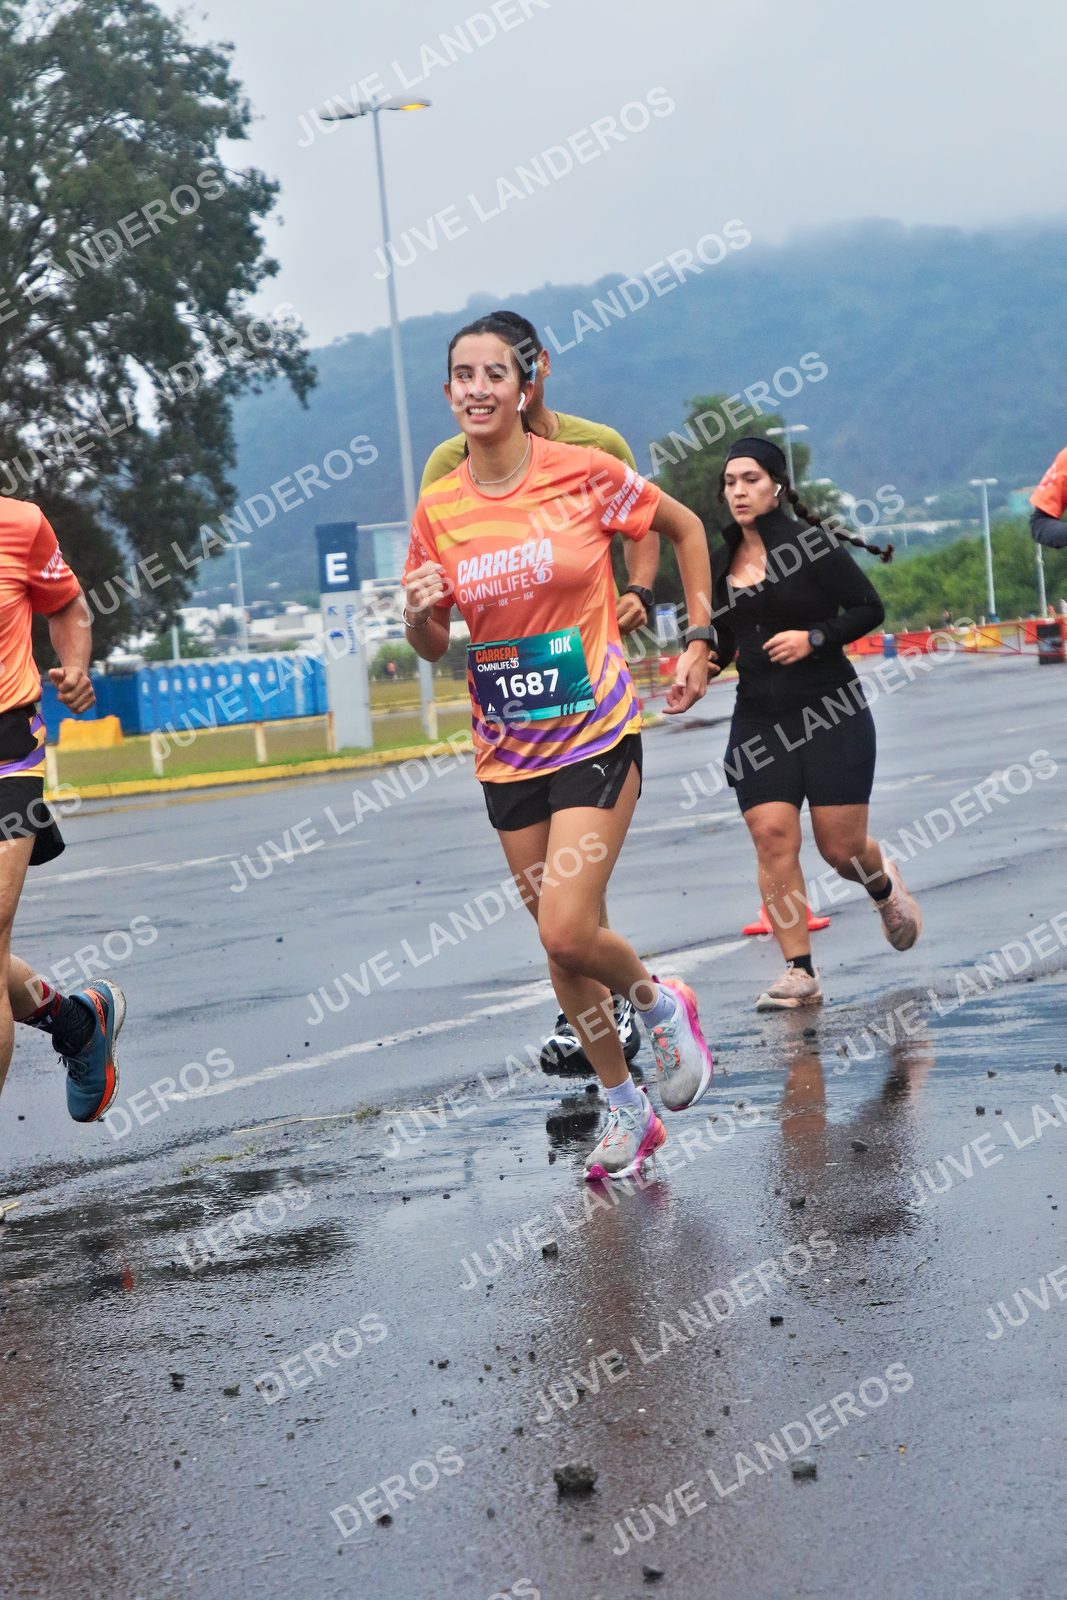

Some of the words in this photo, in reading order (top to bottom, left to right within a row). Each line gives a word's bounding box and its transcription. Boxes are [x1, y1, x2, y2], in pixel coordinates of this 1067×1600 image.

[325, 551, 350, 584] E
[457, 538, 553, 585] CARRERA
[459, 572, 531, 604] OMNILIFE
[475, 646, 518, 664] CARRERA
[548, 635, 572, 656] 10K
[477, 660, 511, 672] OMNILIFE
[495, 668, 559, 699] 1687
